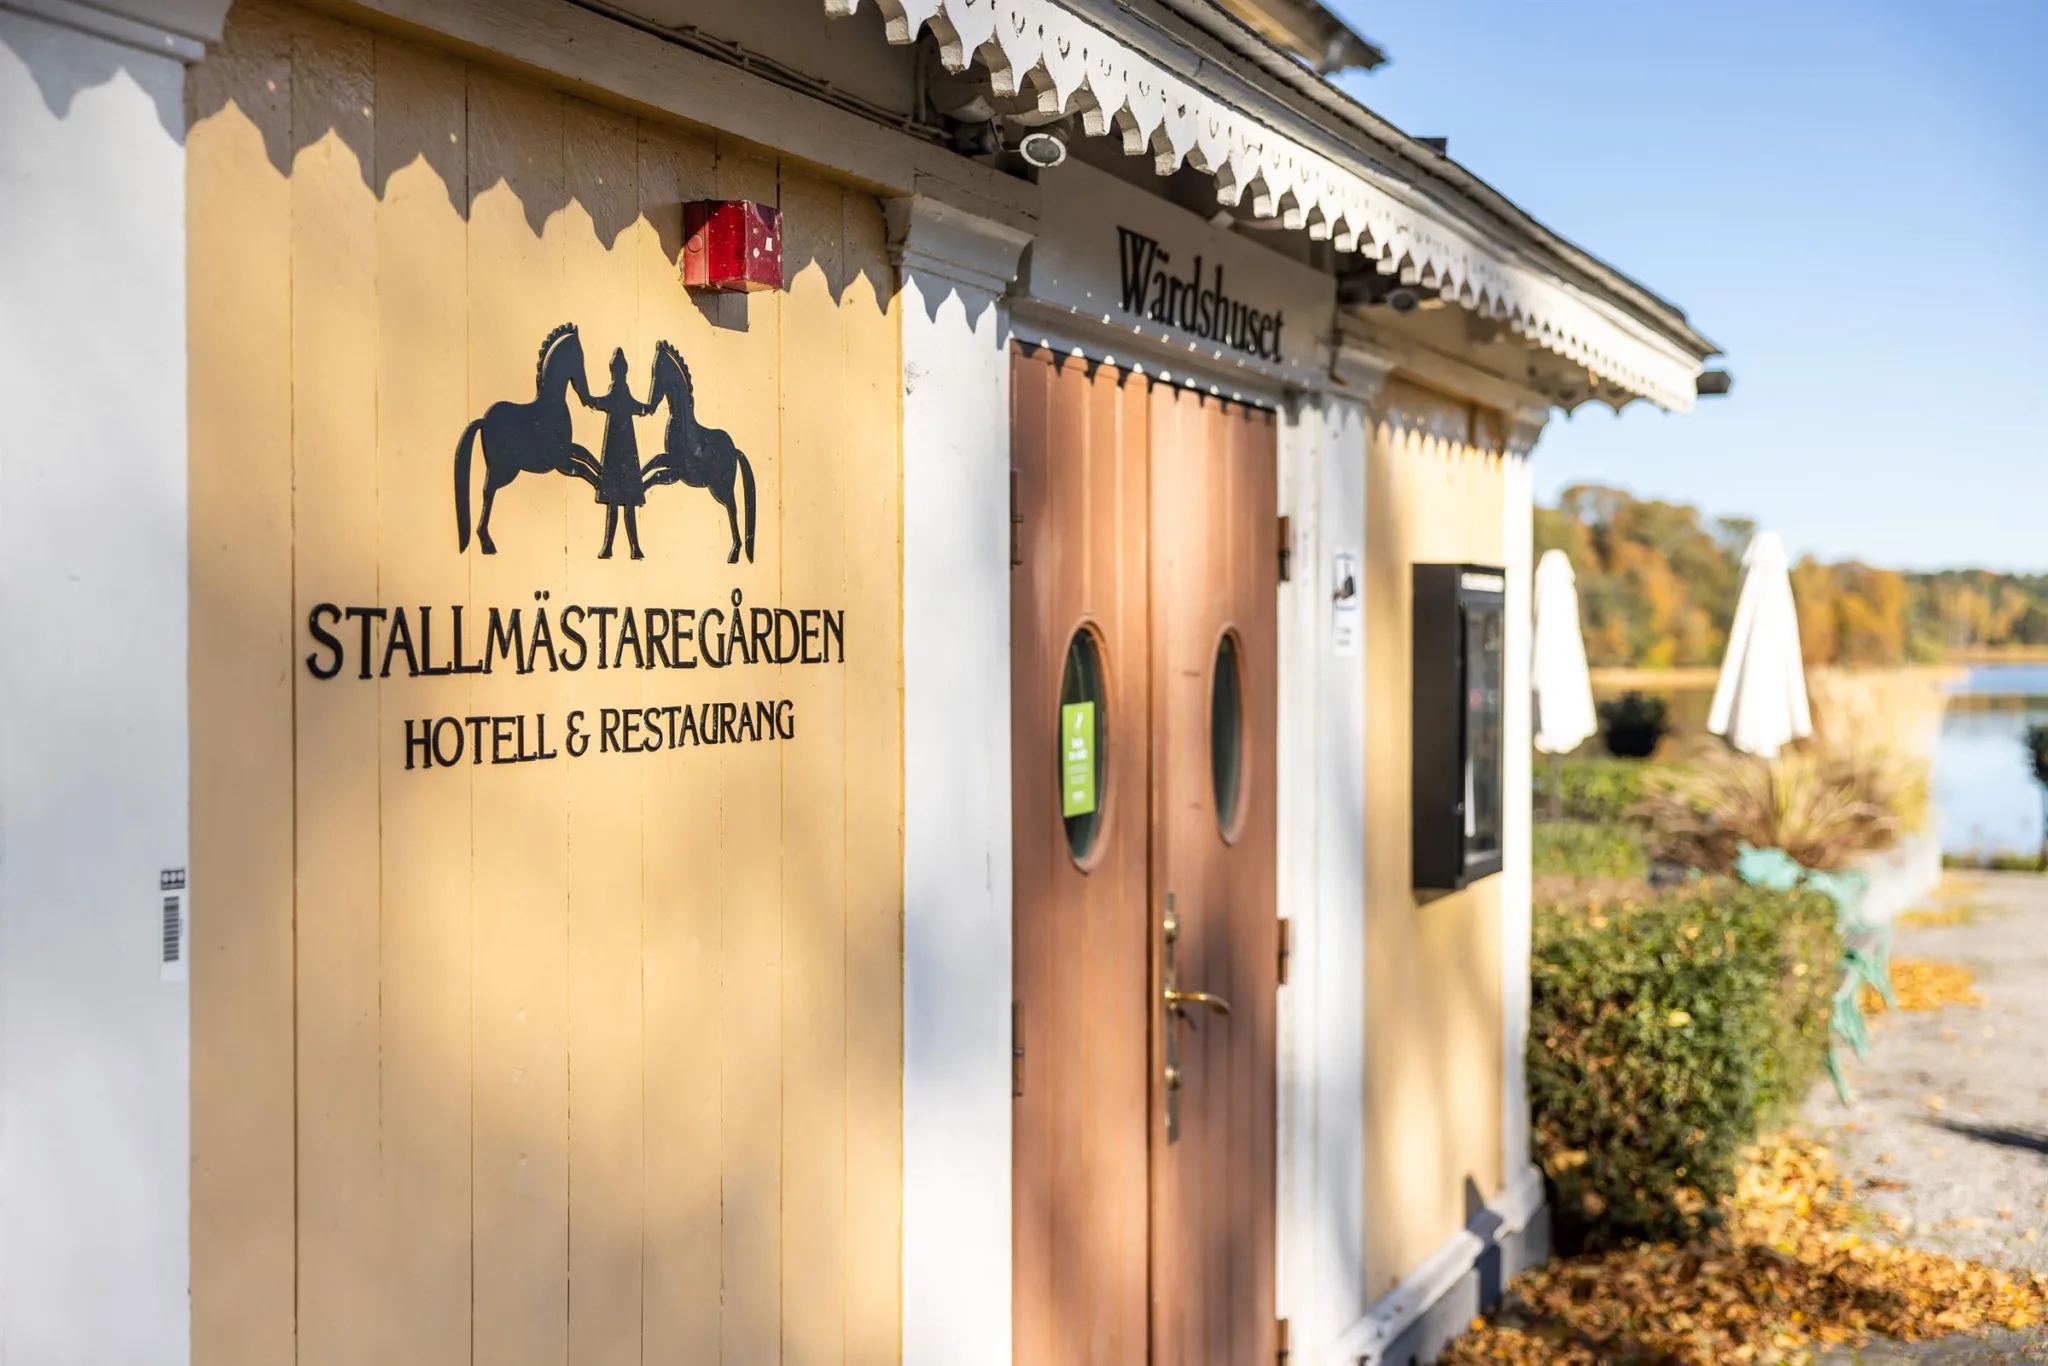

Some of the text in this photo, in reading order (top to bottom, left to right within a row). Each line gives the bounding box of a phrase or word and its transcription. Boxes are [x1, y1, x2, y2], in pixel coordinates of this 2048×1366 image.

[1117, 226, 1284, 363] Wärdshuset
[306, 588, 845, 679] STALLMÄSTAREGÅRDEN
[405, 699, 796, 769] HOTELL & RESTAURANG
